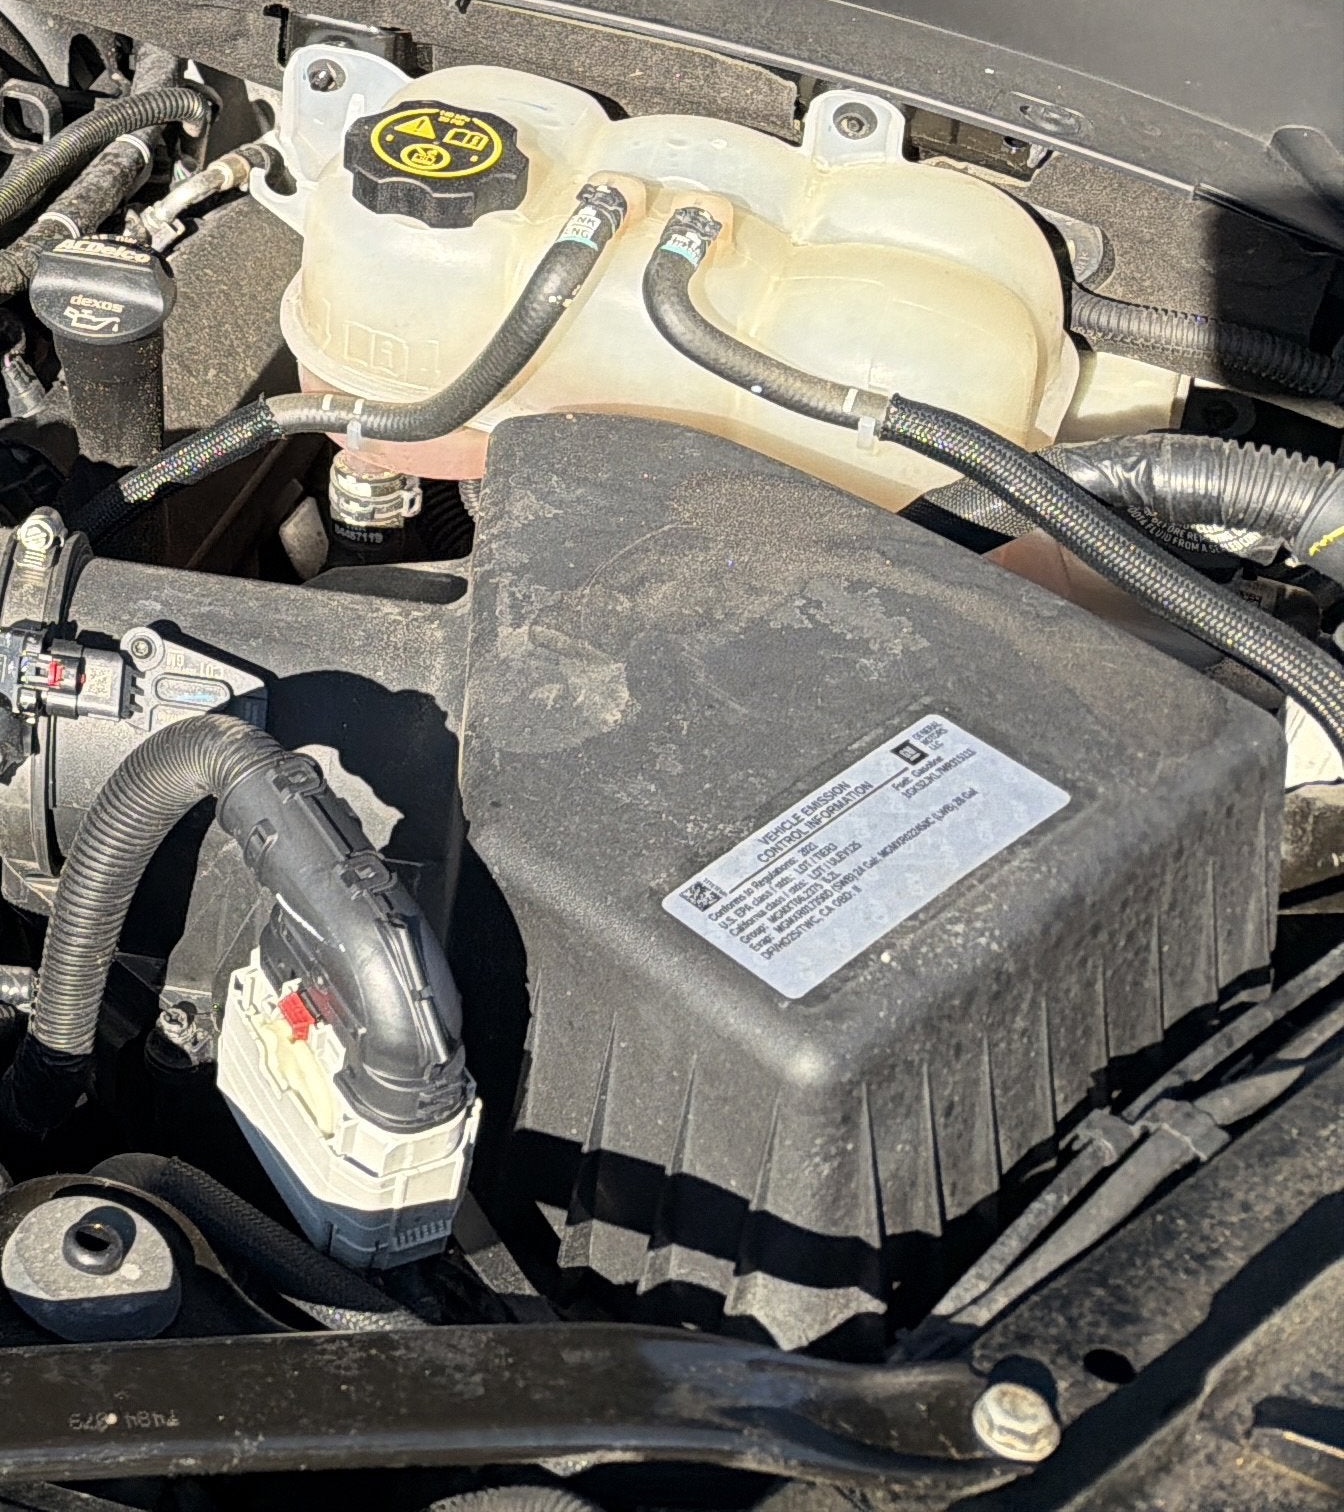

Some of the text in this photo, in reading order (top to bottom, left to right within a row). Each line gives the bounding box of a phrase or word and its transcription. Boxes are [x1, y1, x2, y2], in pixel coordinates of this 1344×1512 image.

[53, 238, 151, 263] ACDelco
[71, 295, 123, 313] dexos
[1144, 522, 1173, 544] FLUID
[1170, 535, 1201, 553] FROM
[910, 755, 943, 777] Gasoline
[756, 780, 873, 862] CONTROL INFORMATION
[757, 780, 851, 845] VEHICLE EMISSION
[707, 893, 746, 921] Conforms
[742, 887, 754, 897] to
[750, 856, 798, 889] Regulations:
[796, 841, 819, 857] 2021
[717, 915, 738, 930] U.S.
[733, 903, 754, 918] EPA
[751, 889, 773, 906] class
[811, 842, 838, 860] TIER3
[728, 909, 767, 936] California
[764, 895, 786, 911] class
[818, 904, 835, 917] CA
[831, 890, 856, 907] OBD:
[739, 922, 769, 944] Group:
[748, 933, 774, 951] Evap:
